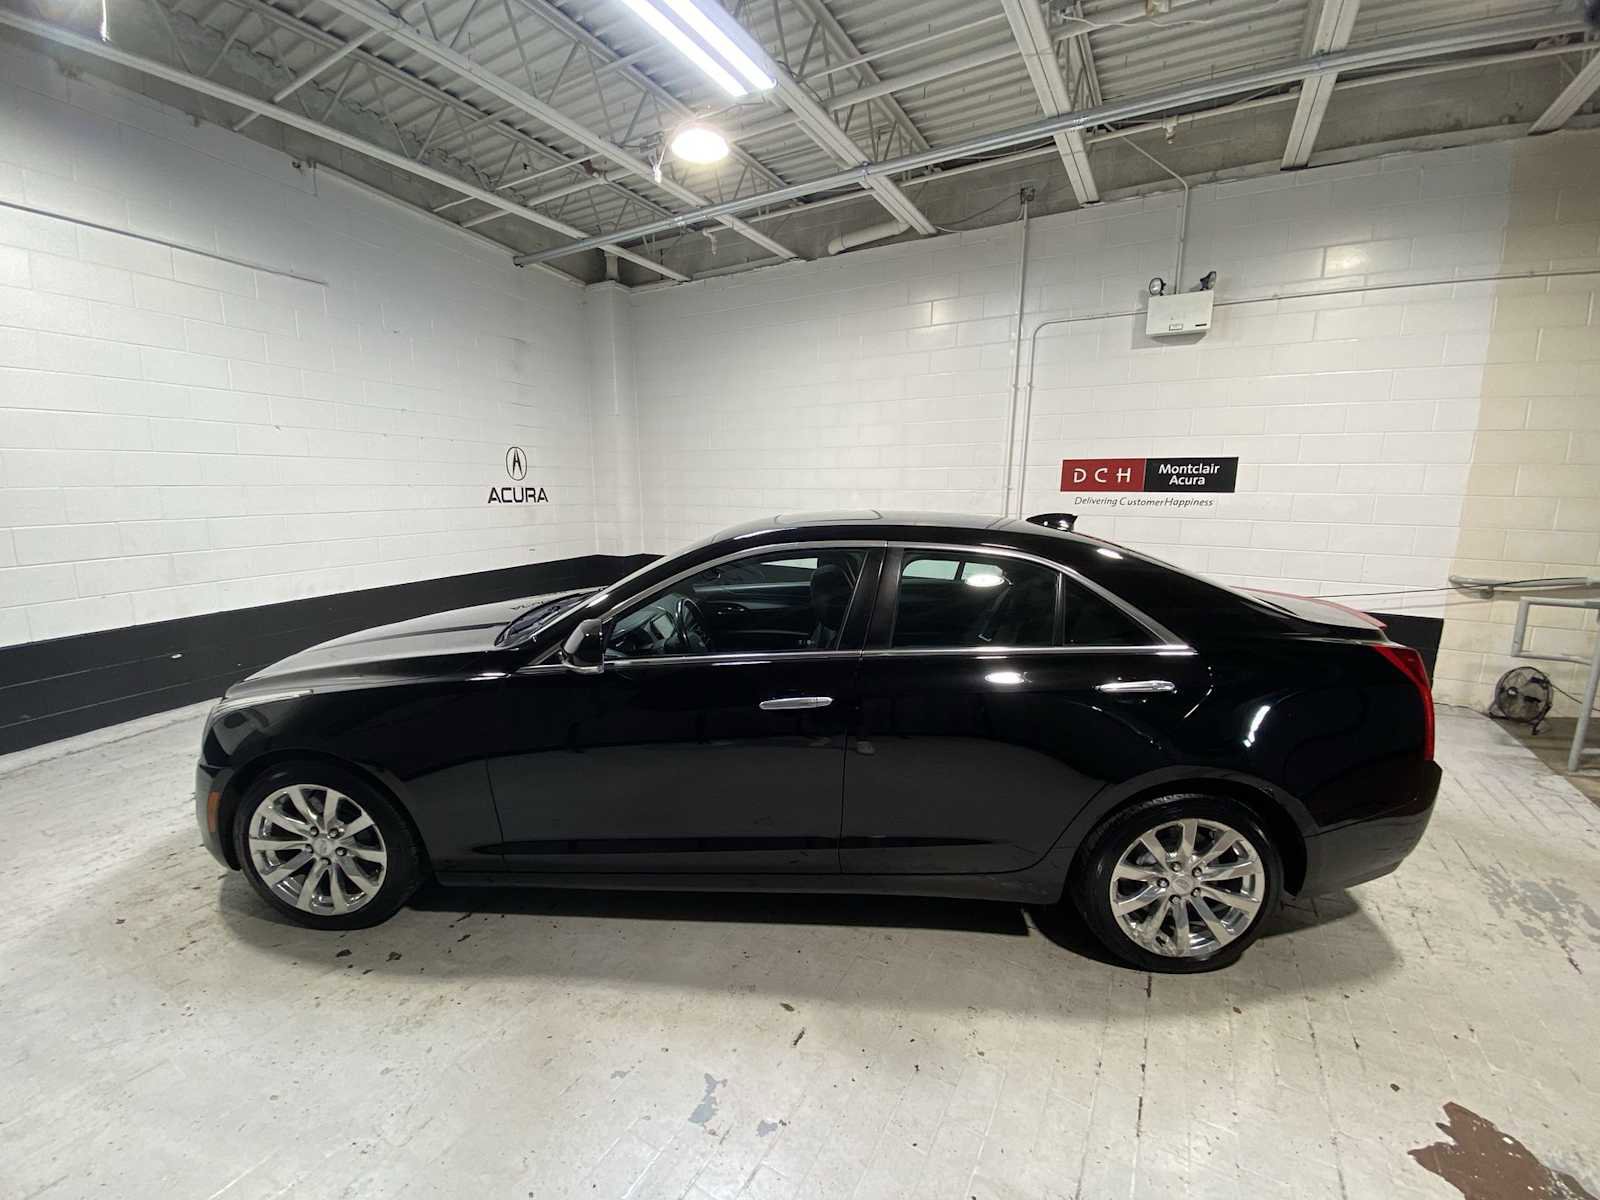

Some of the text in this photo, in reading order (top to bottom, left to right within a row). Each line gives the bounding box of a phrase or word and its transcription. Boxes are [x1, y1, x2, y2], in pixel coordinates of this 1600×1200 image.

[1073, 467, 1132, 483] DCH
[1158, 463, 1220, 475] Montclair
[1168, 475, 1206, 486] Acura
[487, 487, 549, 504] ACURA
[1074, 496, 1118, 508] Delivering
